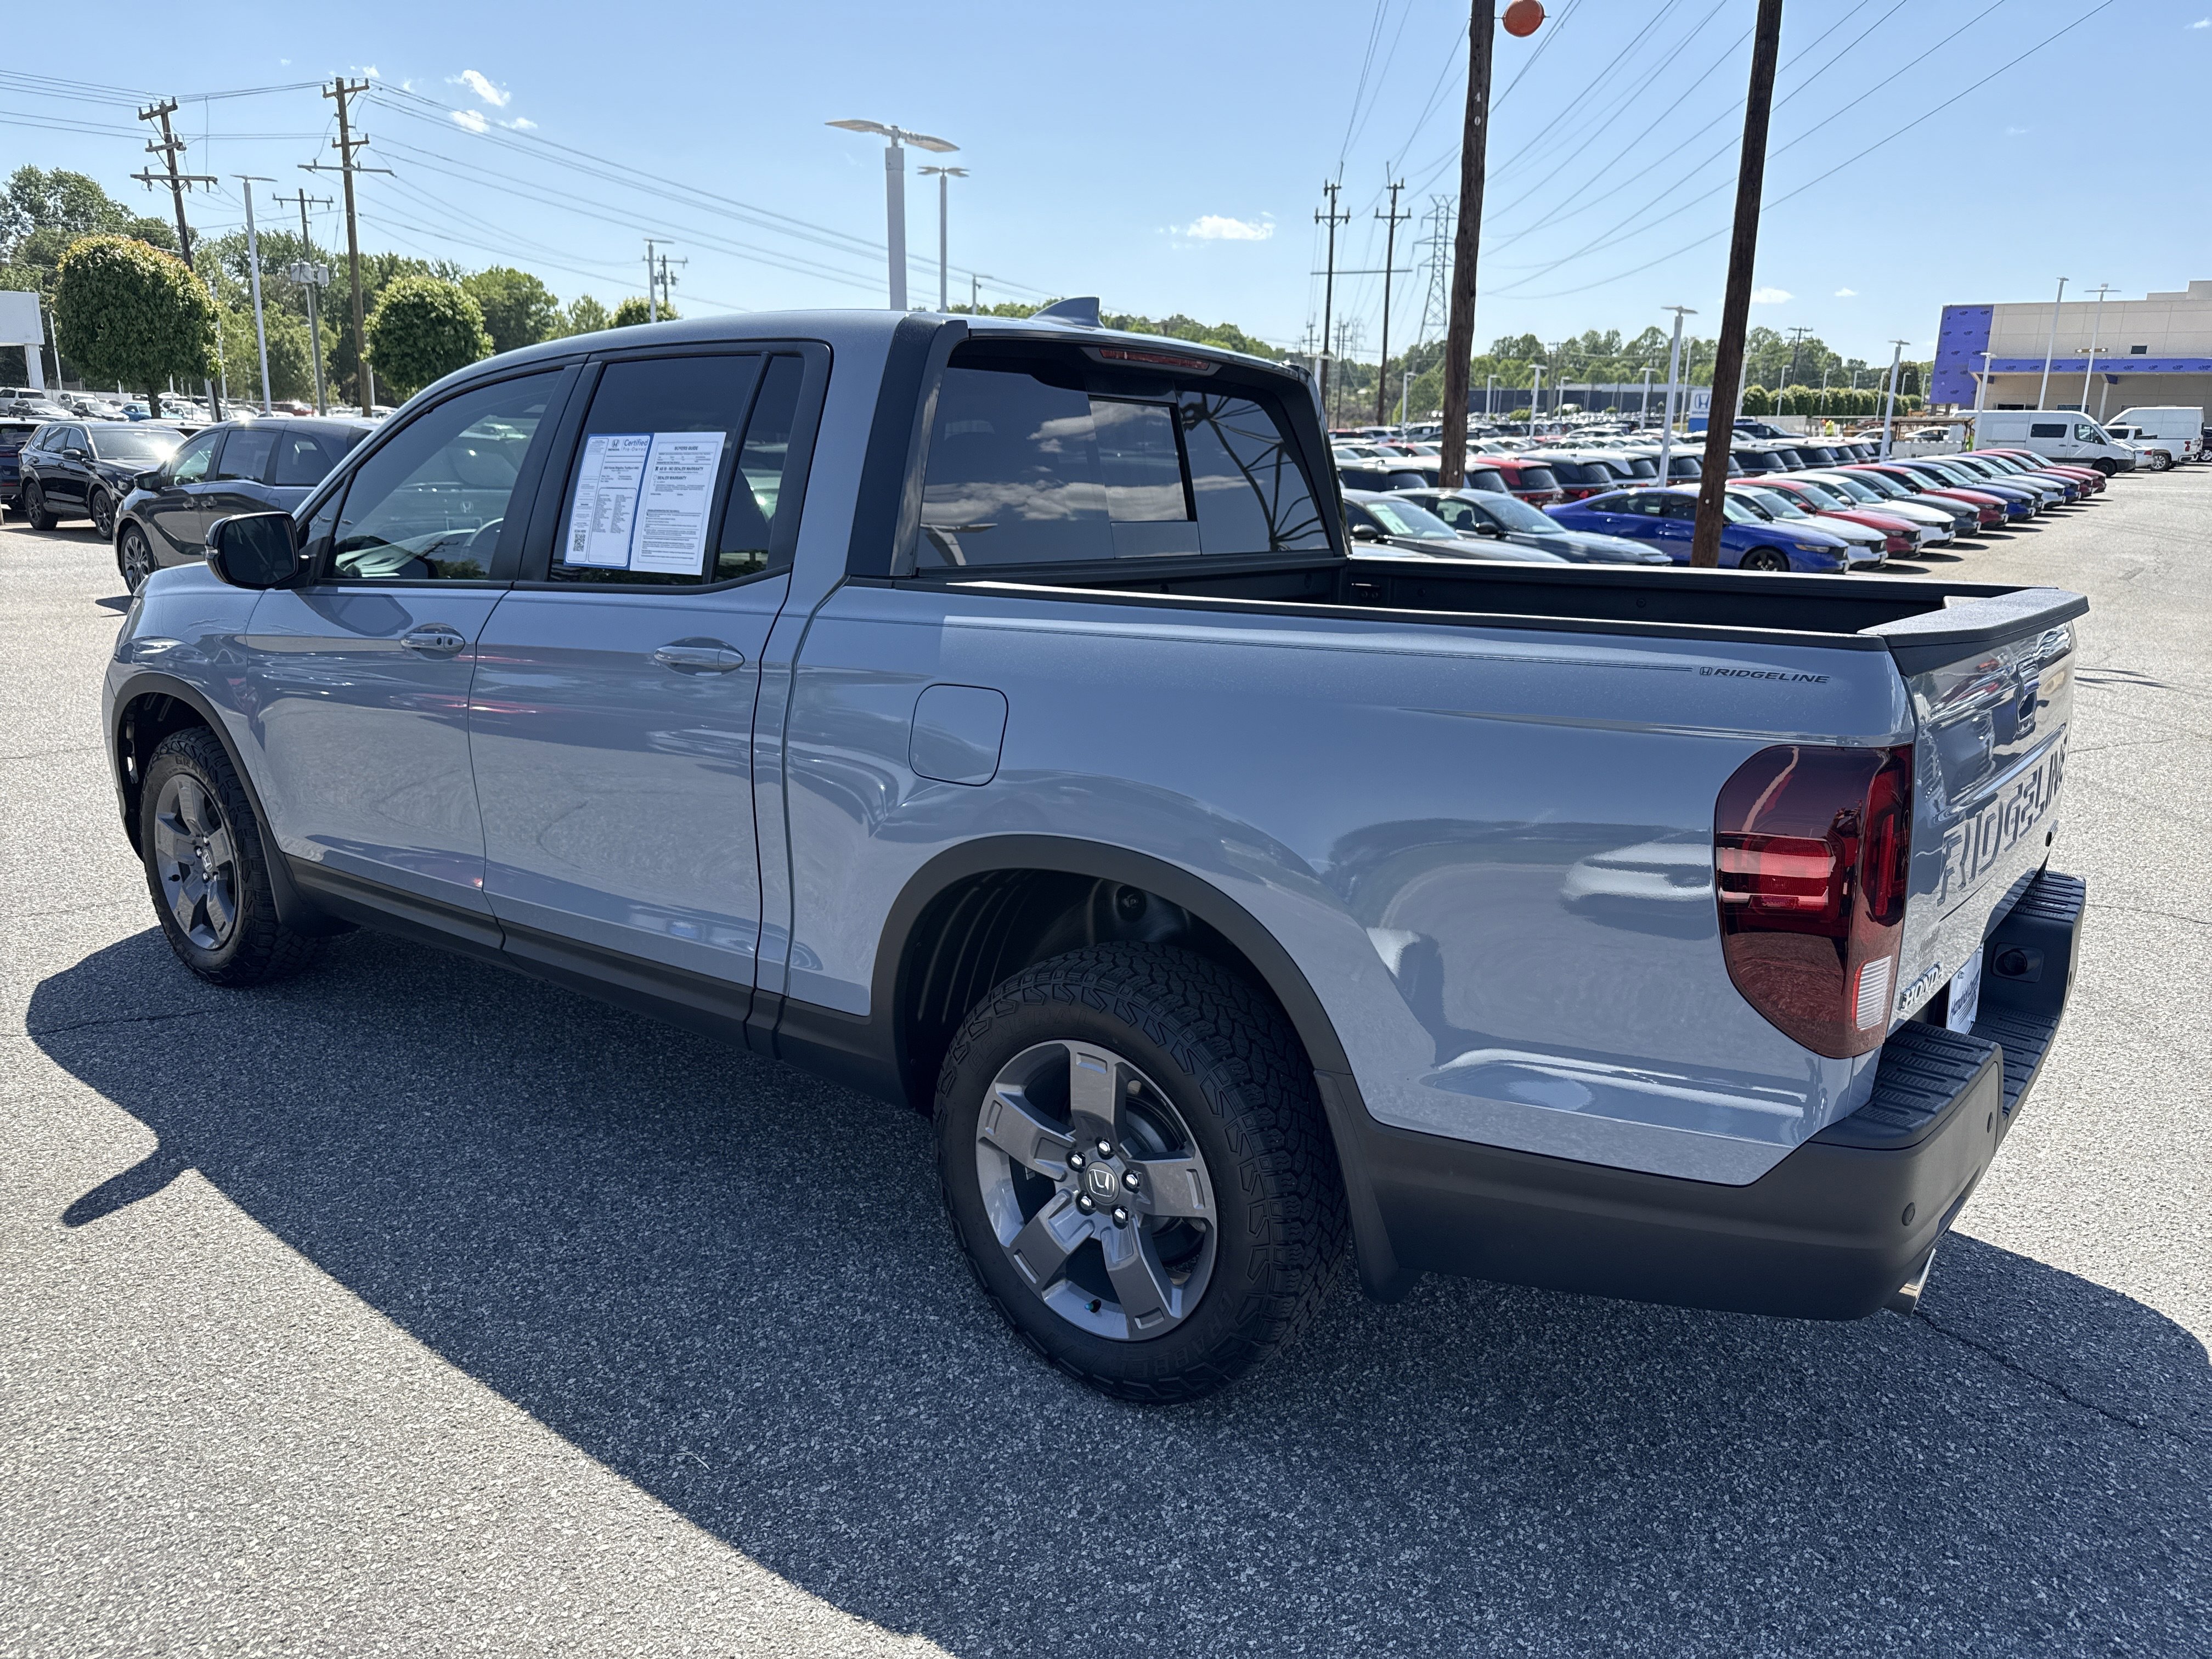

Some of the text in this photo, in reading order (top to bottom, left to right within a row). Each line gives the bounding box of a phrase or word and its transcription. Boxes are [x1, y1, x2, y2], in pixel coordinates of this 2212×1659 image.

[624, 438, 648, 447] Certified
[1713, 668, 1830, 684] RIDGELINE
[1937, 733, 2068, 907] RIDGELINE
